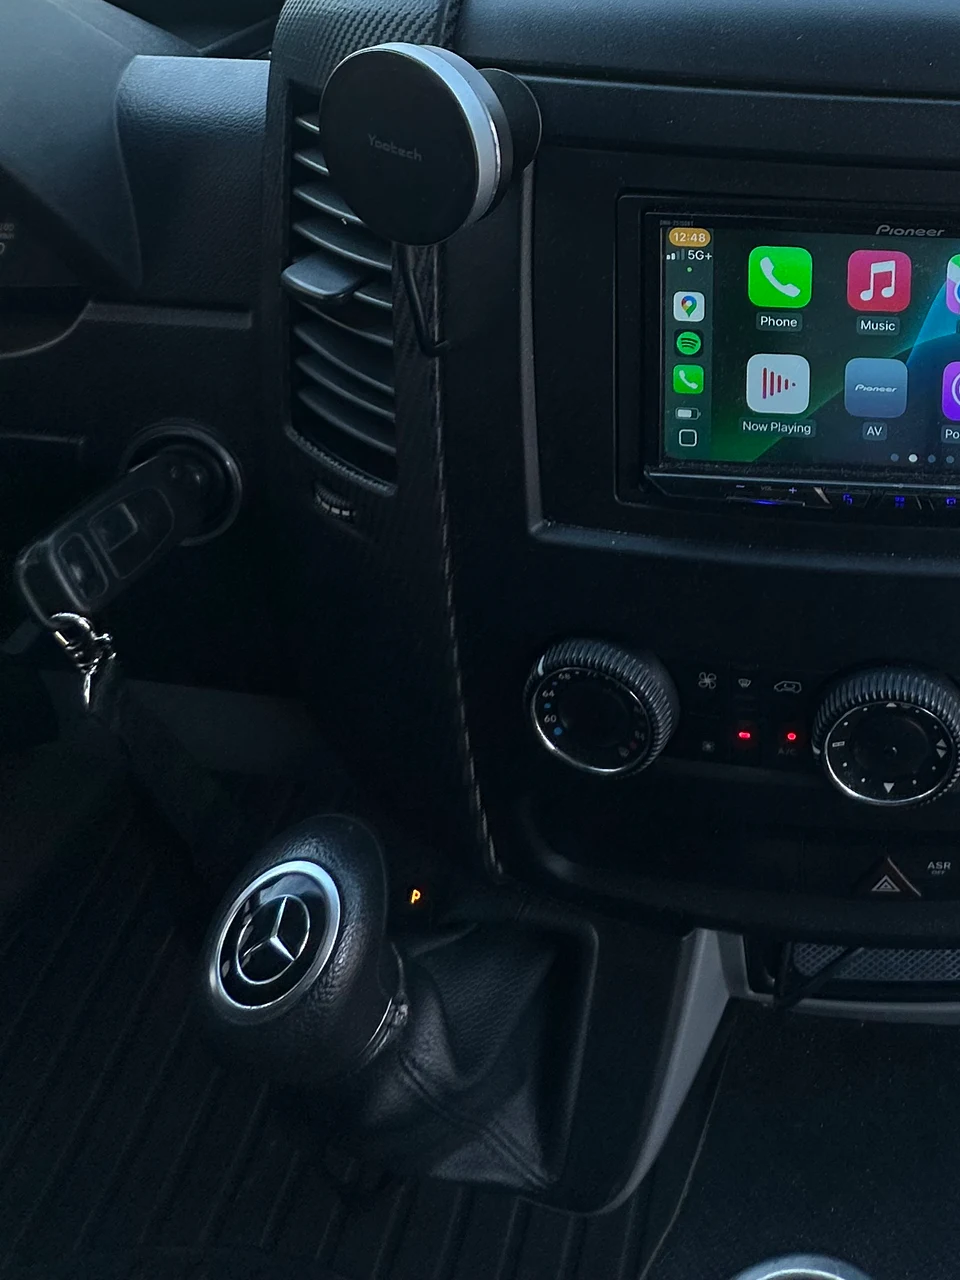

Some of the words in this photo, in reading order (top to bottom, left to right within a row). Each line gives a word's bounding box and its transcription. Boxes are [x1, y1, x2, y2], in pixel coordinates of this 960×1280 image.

[367, 132, 423, 163] Yootech
[875, 224, 946, 237] Pioneer
[673, 232, 706, 243] 12:48
[687, 249, 713, 261] 5G+
[760, 316, 798, 327] Phone
[860, 320, 896, 331] Music
[854, 383, 898, 393] Pioneer
[742, 421, 768, 432] Now
[770, 422, 812, 436] Playing
[866, 426, 883, 436] AV
[543, 714, 557, 723] 60
[927, 861, 951, 870] ASR
[411, 889, 421, 904] P
